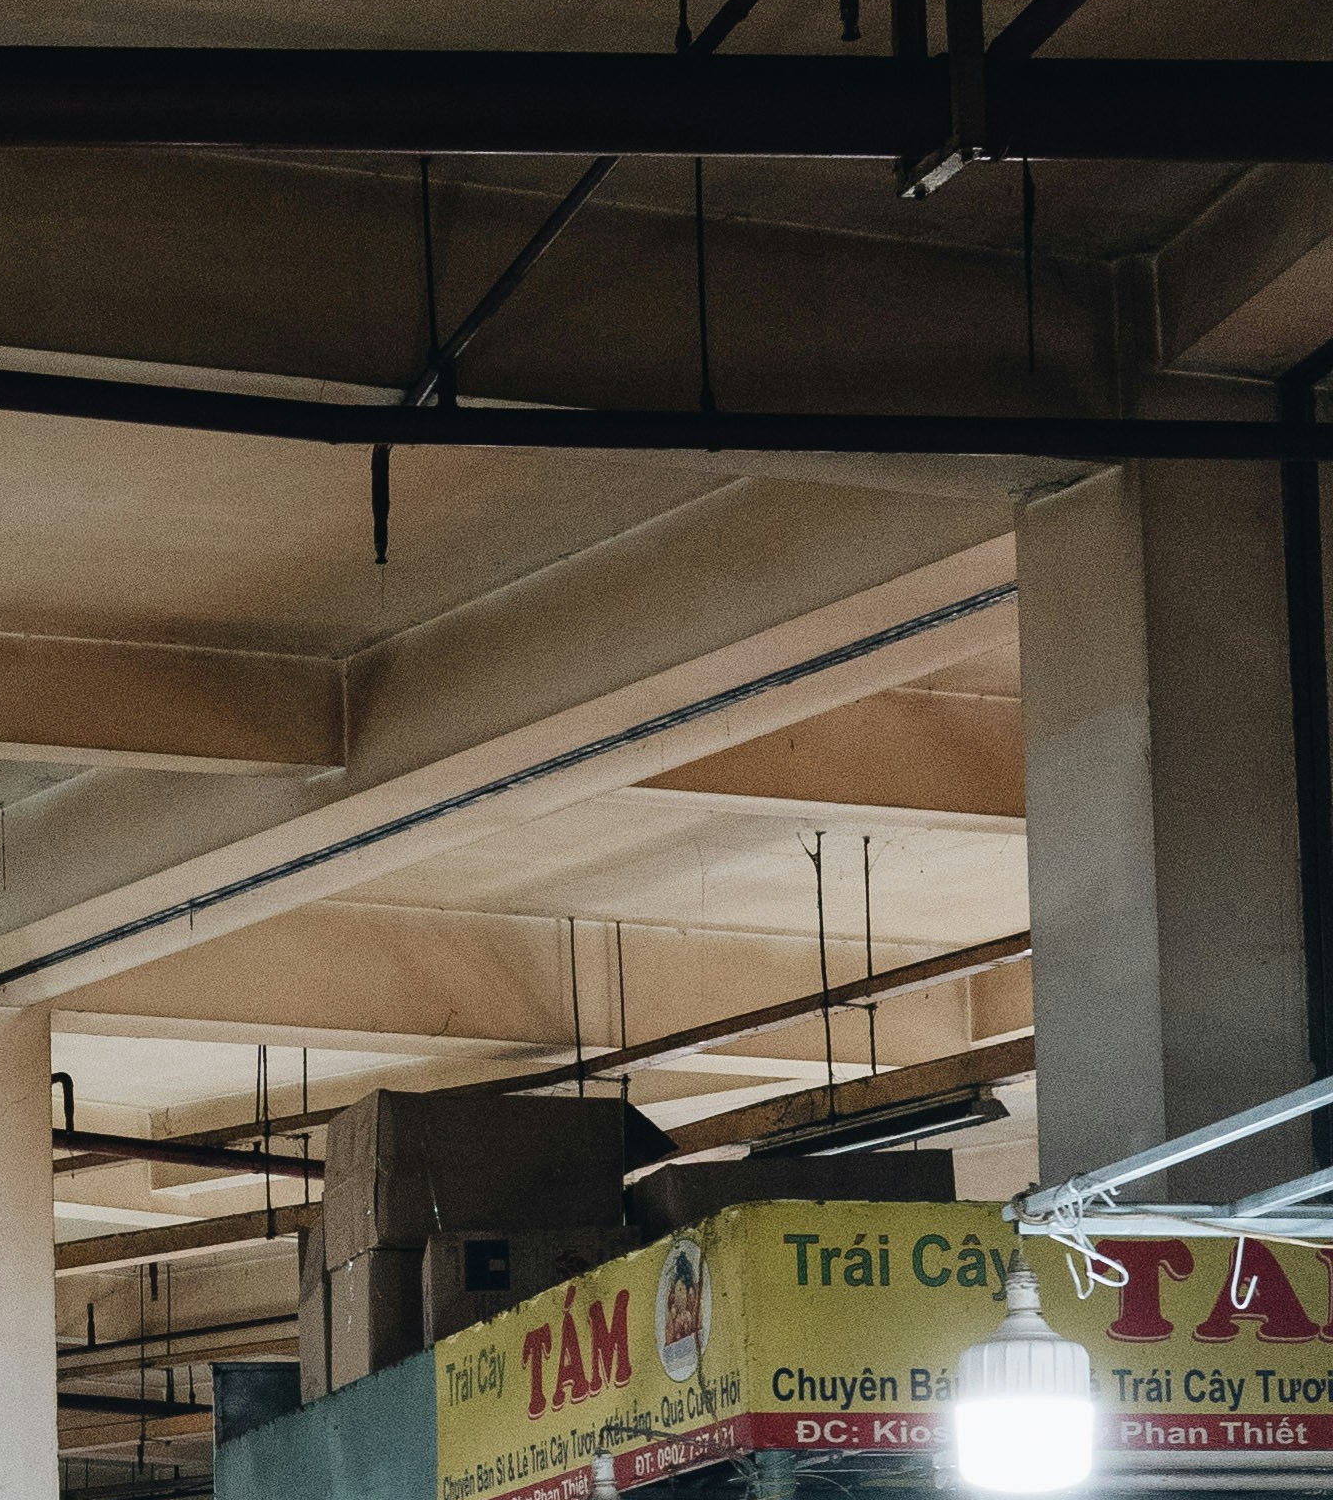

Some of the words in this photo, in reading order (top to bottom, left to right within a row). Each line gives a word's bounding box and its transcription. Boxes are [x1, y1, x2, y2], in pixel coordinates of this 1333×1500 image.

[783, 1234, 890, 1288] Trái
[446, 1355, 473, 1406] Trái
[477, 1345, 506, 1399] Cây
[521, 1285, 632, 1421] TÁM
[772, 1368, 899, 1410] Chuyên
[1112, 1368, 1172, 1403] Trái
[1183, 1366, 1247, 1410] Cây
[794, 1420, 861, 1443] ĐC:
[1121, 1421, 1209, 1444] Phan
[1220, 1415, 1308, 1444] Thiết
